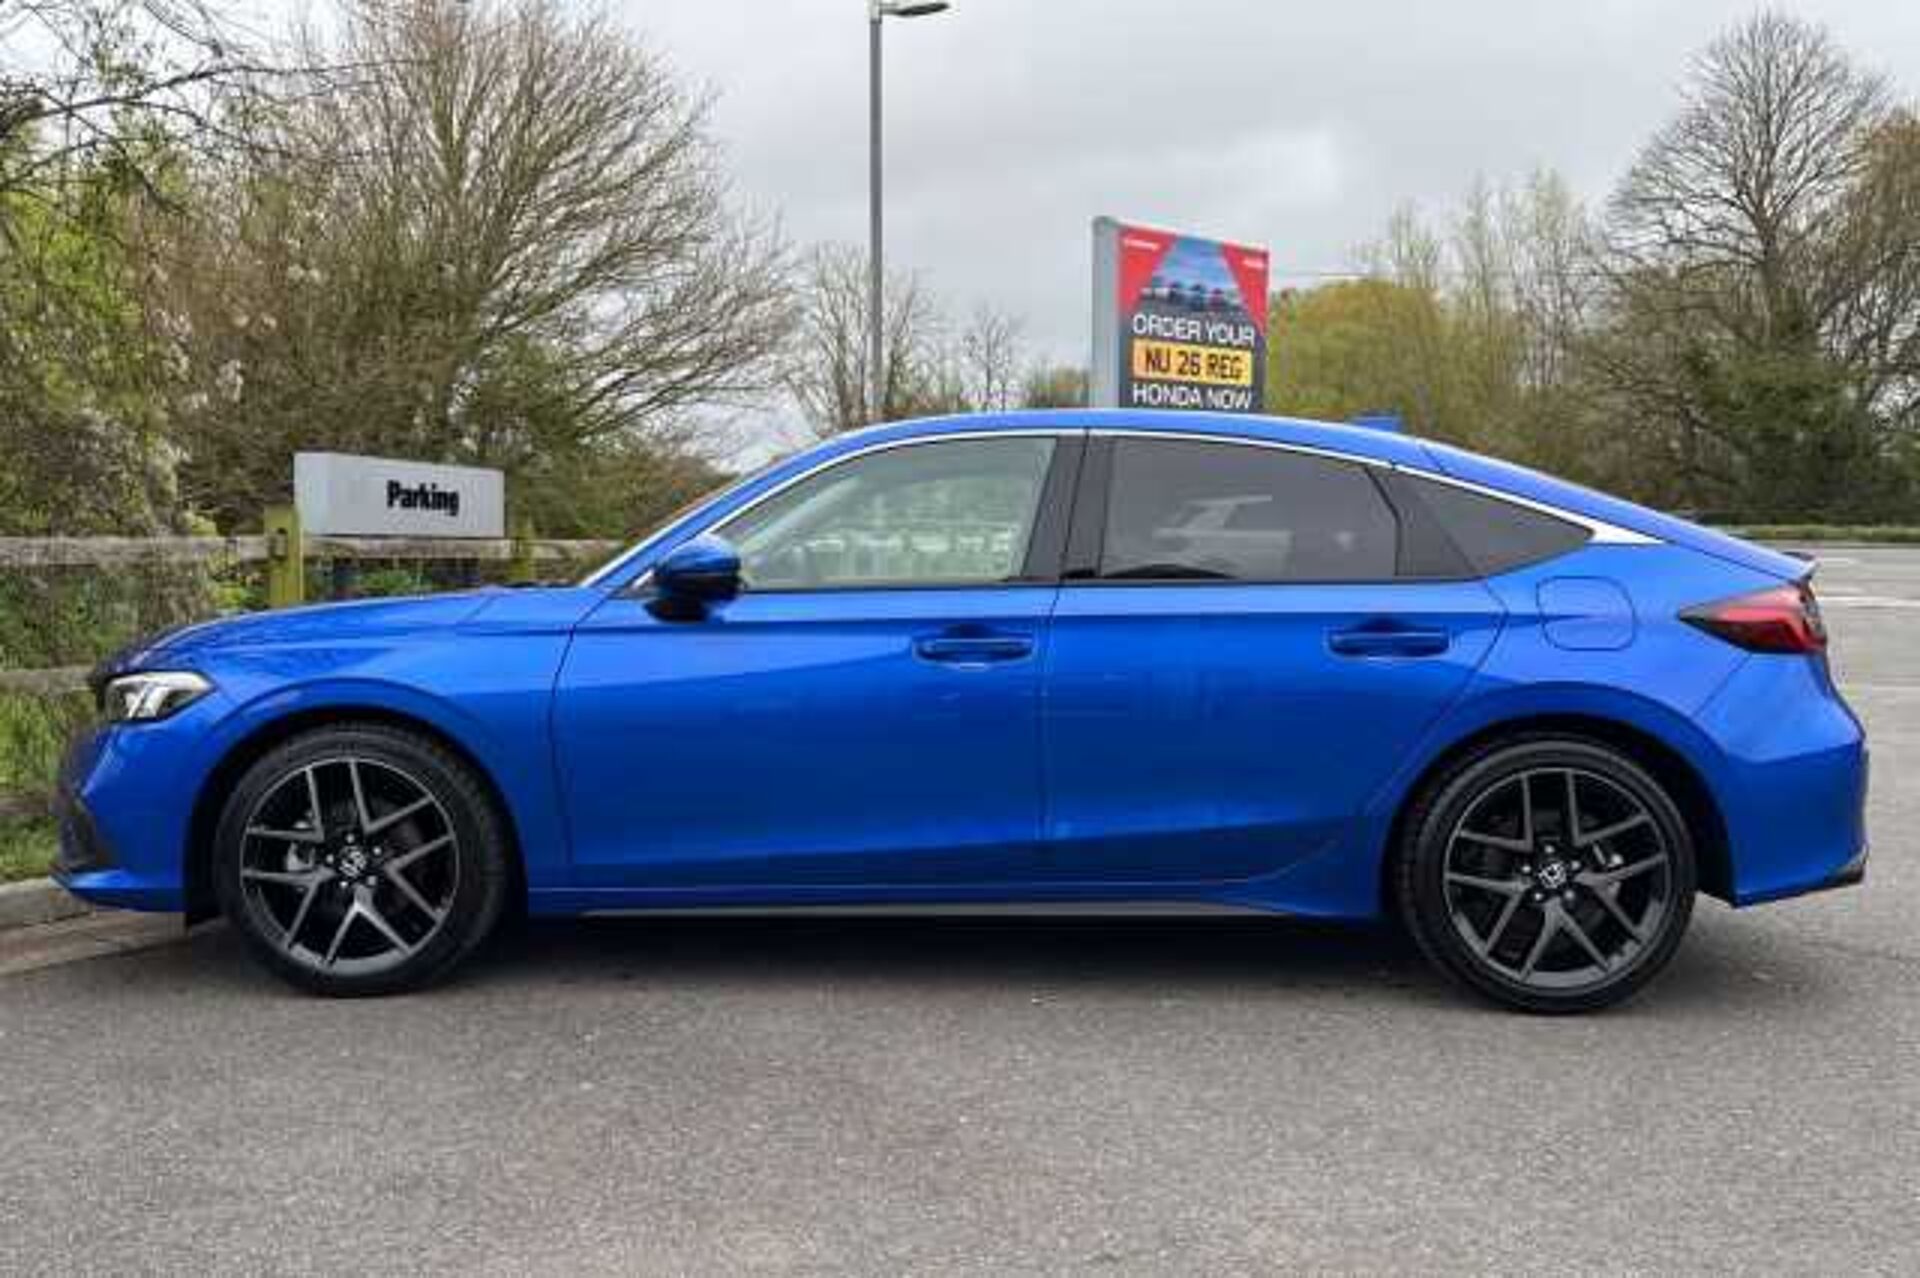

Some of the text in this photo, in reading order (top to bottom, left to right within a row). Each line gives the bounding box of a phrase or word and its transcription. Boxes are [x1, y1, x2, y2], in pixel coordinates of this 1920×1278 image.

[1133, 314, 1255, 347] ORDER YOUR
[1145, 347, 1171, 373] NU
[1206, 354, 1243, 380] REG
[1133, 383, 1252, 409] HONDA NOW
[386, 479, 460, 517] Parking
